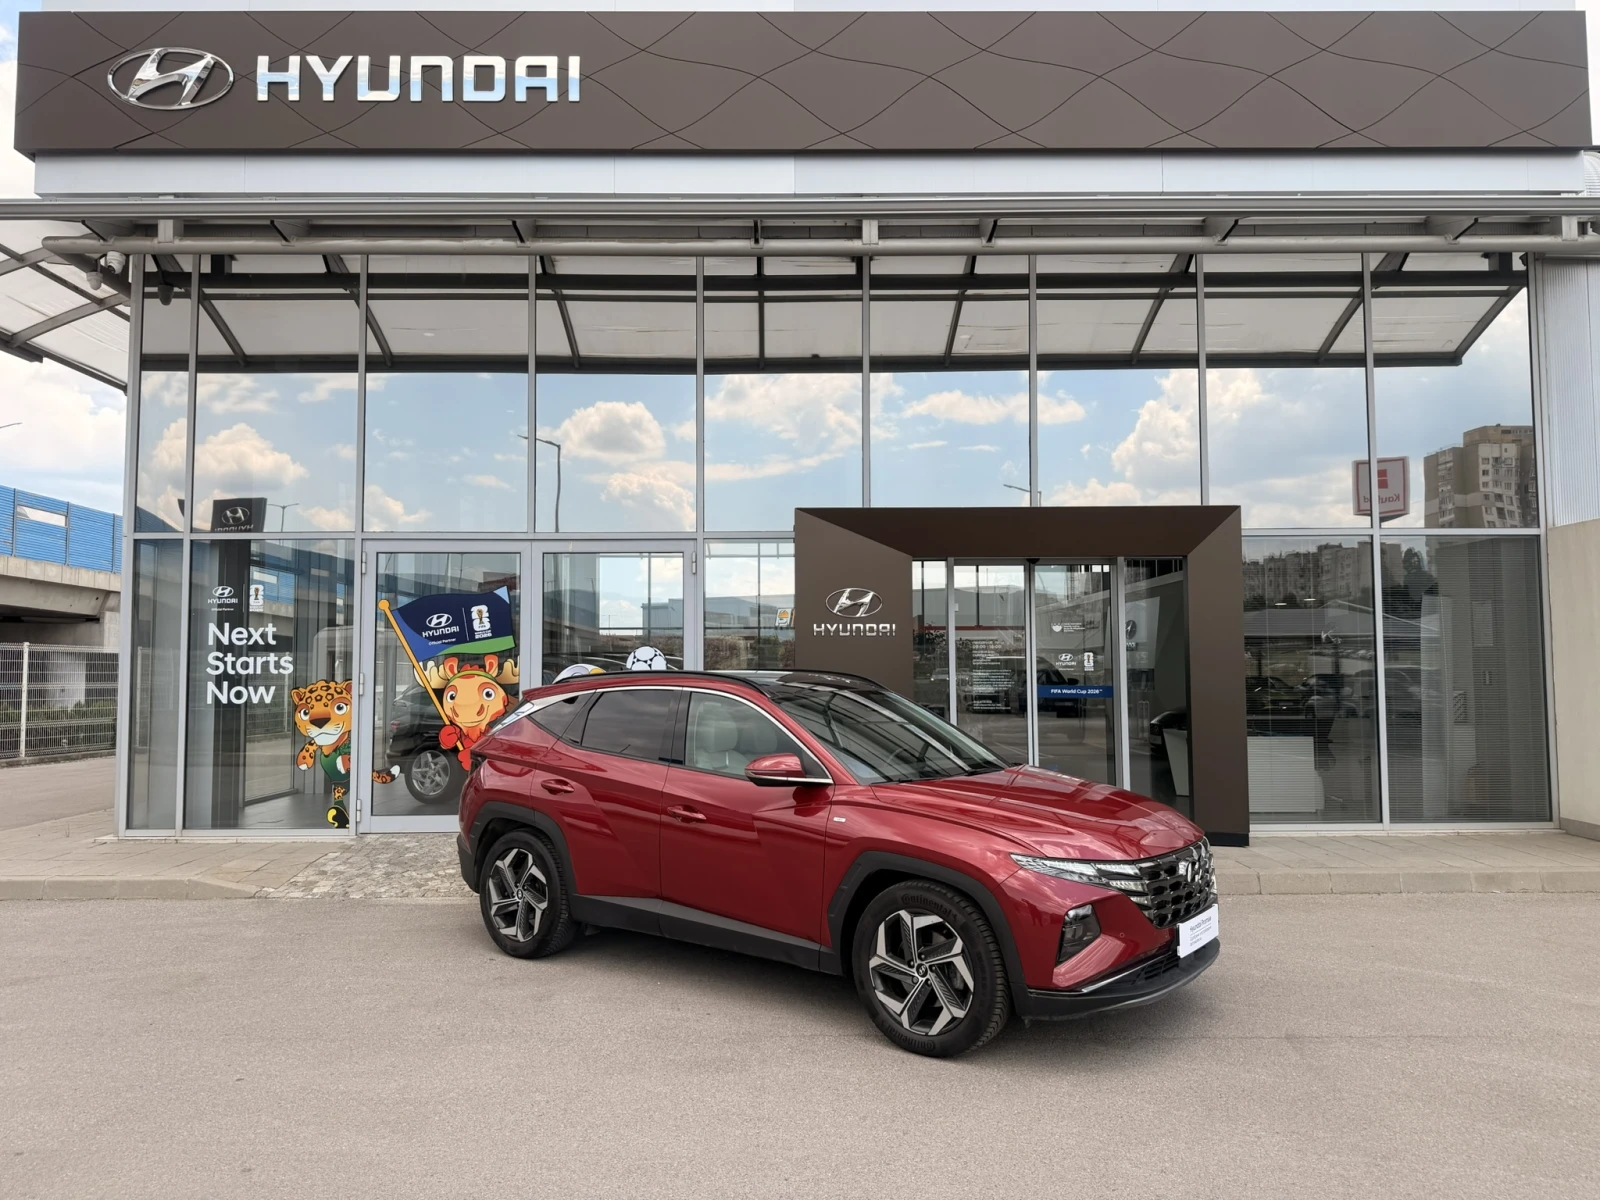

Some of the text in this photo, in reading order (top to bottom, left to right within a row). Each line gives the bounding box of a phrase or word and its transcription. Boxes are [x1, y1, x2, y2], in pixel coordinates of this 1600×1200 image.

[256, 55, 581, 102] HYUNDAI
[208, 622, 277, 646] Next
[422, 625, 459, 638] HYUNDAI
[813, 623, 896, 637] HYUNDAI
[206, 651, 294, 676] Starts
[206, 681, 276, 705] Now
